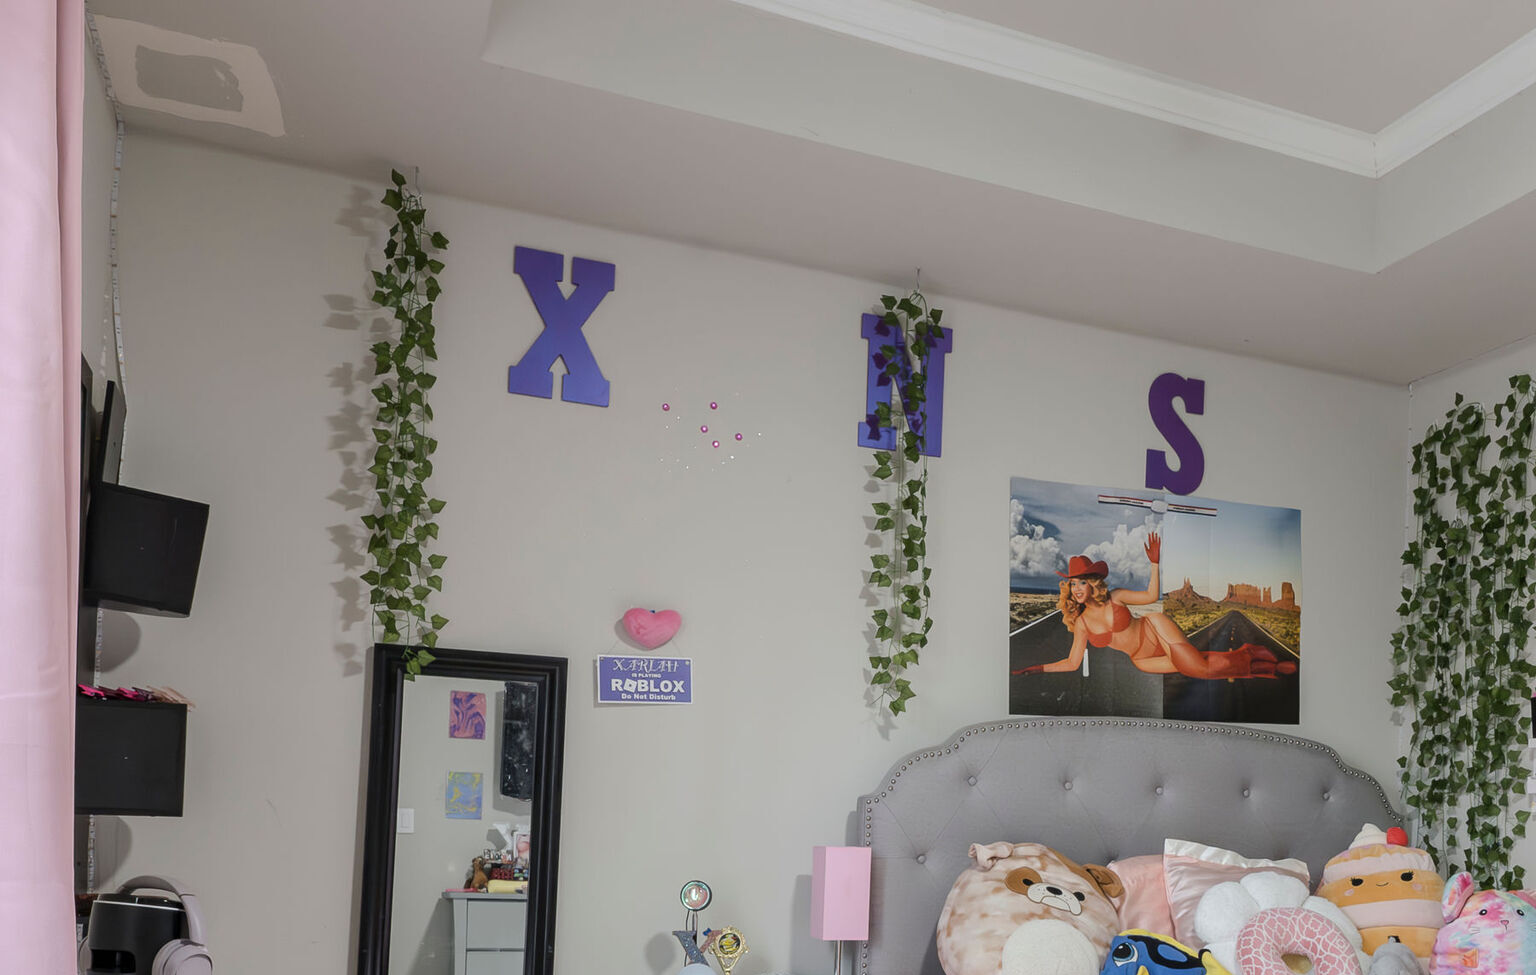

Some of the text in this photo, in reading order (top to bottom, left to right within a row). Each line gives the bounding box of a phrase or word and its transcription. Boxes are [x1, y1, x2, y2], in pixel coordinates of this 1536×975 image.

[508, 245, 1206, 496] X N S
[611, 678, 685, 693] ROBLOX
